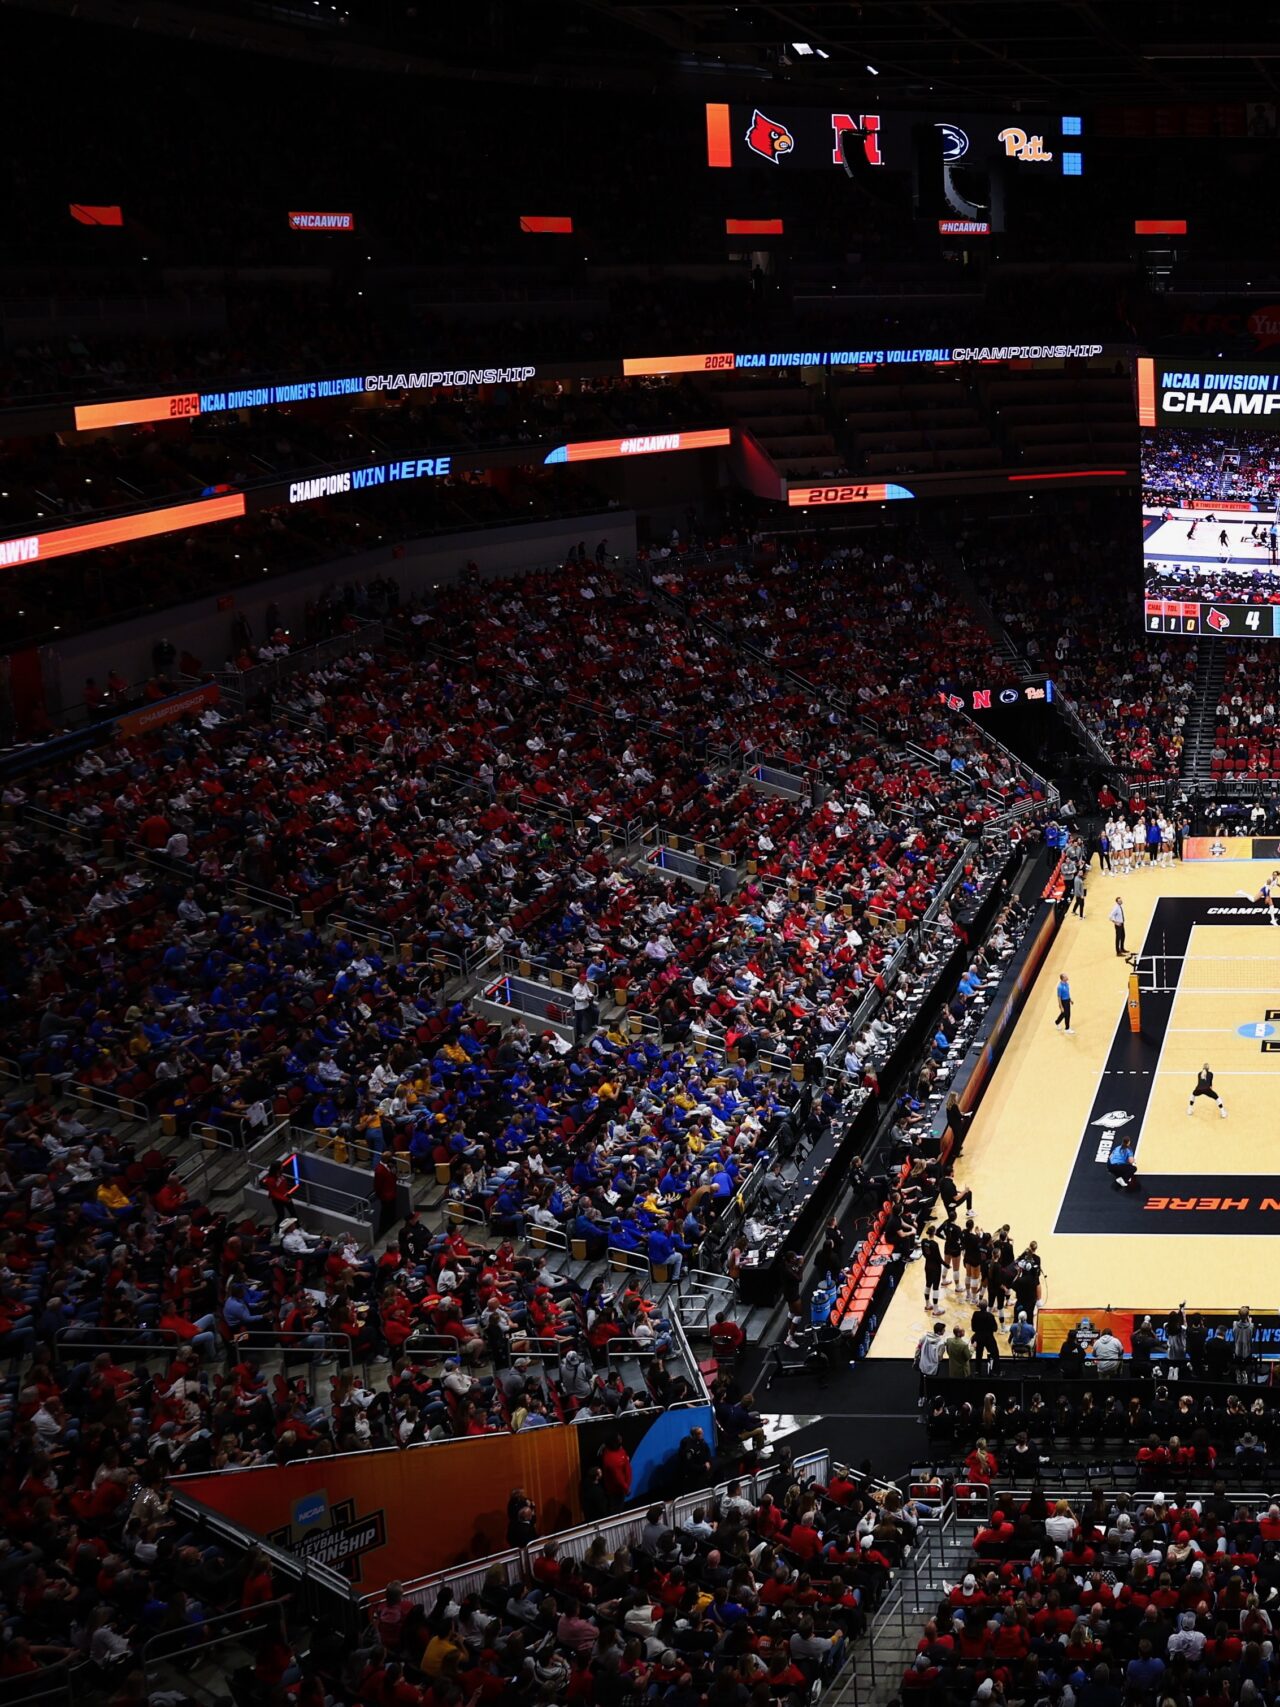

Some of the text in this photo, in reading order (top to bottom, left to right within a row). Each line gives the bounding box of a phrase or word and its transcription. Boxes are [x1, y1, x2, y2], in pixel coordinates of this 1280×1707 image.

[293, 215, 350, 228] #NCAAWVB
[941, 222, 987, 232] #NCAAWVB
[1180, 311, 1242, 336] KFC
[705, 354, 733, 369] 2024
[735, 354, 766, 368] NCAA
[769, 352, 821, 367] DIVISION
[829, 350, 884, 365] WOMEN'S
[886, 348, 950, 363] VOLLEYBALL
[952, 344, 1103, 361] CHAMPIONSHIP
[170, 396, 198, 416] 2024
[200, 393, 226, 413] NCAA
[228, 388, 269, 410] DIVISION
[275, 382, 317, 403] WOMEN'S
[318, 377, 364, 398] VOLLEYBALL
[364, 366, 536, 396] CHAMPIONSHIP
[1162, 372, 1200, 390] NCAA
[1203, 374, 1268, 391] DIVISION
[1272, 374, 1278, 391] I
[619, 434, 680, 454] #NCAAWVB
[289, 457, 451, 504] CHAMPIONS WIN HERE
[808, 486, 869, 503] 2024
[1150, 617, 1159, 629] 2
[1170, 618, 1176, 630] 1
[1186, 619, 1196, 631] 0
[1245, 611, 1260, 631] 4
[973, 689, 992, 709] N
[1024, 687, 1045, 700] Pitt
[139, 694, 205, 726] CHAMPIONSHIP
[1144, 1197, 1250, 1210] HERE
[298, 1504, 325, 1523] NCAA
